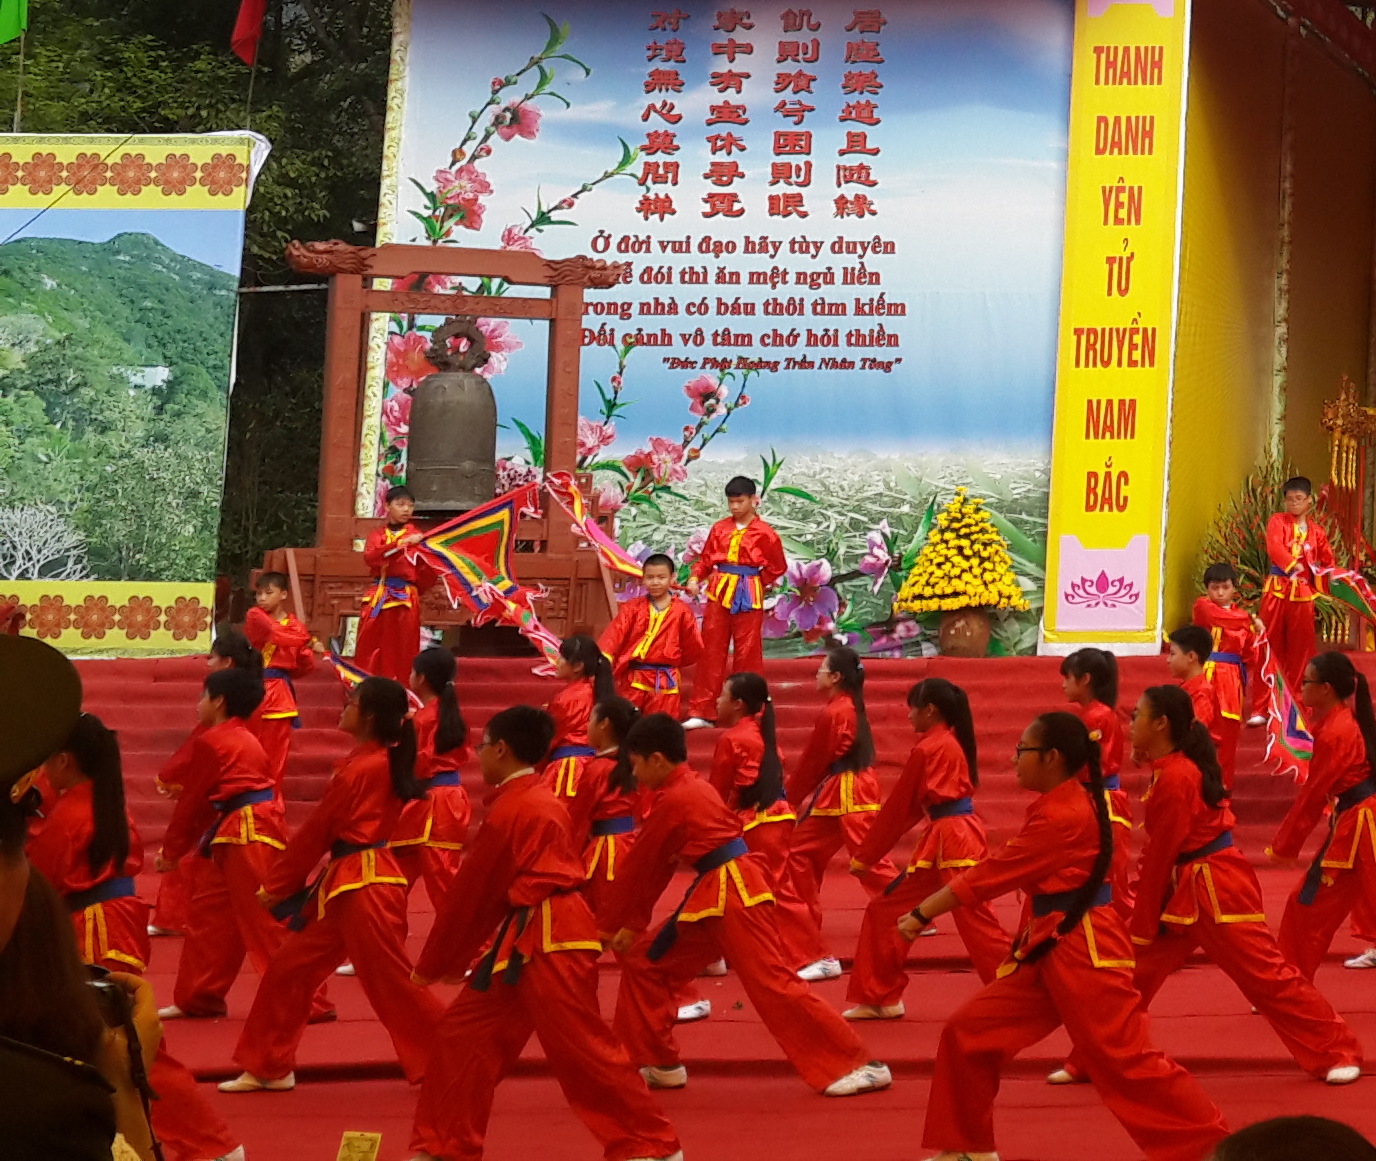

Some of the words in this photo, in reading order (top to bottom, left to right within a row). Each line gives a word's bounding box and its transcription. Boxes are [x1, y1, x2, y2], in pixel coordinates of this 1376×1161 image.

[1093, 46, 1163, 85] THANH
[1095, 116, 1154, 155] DANH
[1102, 177, 1142, 225] YÊN
[591, 230, 612, 253] Ở
[616, 234, 652, 254] đời
[658, 235, 691, 254] vui
[697, 235, 737, 259] đạo
[743, 236, 783, 259] hãy
[788, 235, 825, 259] tùy
[830, 235, 896, 259] duyên
[638, 266, 673, 285] đói
[679, 266, 708, 285] thì
[714, 266, 741, 285] ăn
[747, 266, 789, 290] mệt
[794, 266, 835, 290] ngủ
[841, 261, 881, 286] liền
[1106, 238, 1134, 297] TỬ
[583, 301, 633, 320] rong
[638, 297, 679, 315] nhà
[685, 297, 710, 316] có
[716, 297, 756, 316] báu
[762, 297, 805, 316] thôi
[810, 297, 848, 316] tìm
[853, 292, 906, 317] kiếm
[621, 328, 673, 347] cảnh
[679, 327, 705, 347] vô
[711, 327, 753, 347] tâm
[759, 328, 800, 347] chớ
[805, 328, 839, 347] hỏi
[845, 323, 900, 347] thiền
[1074, 312, 1156, 368] TRUYỀN
[817, 357, 855, 370] Nhân
[1085, 399, 1136, 439] NAM
[1085, 457, 1129, 512] BẮC
